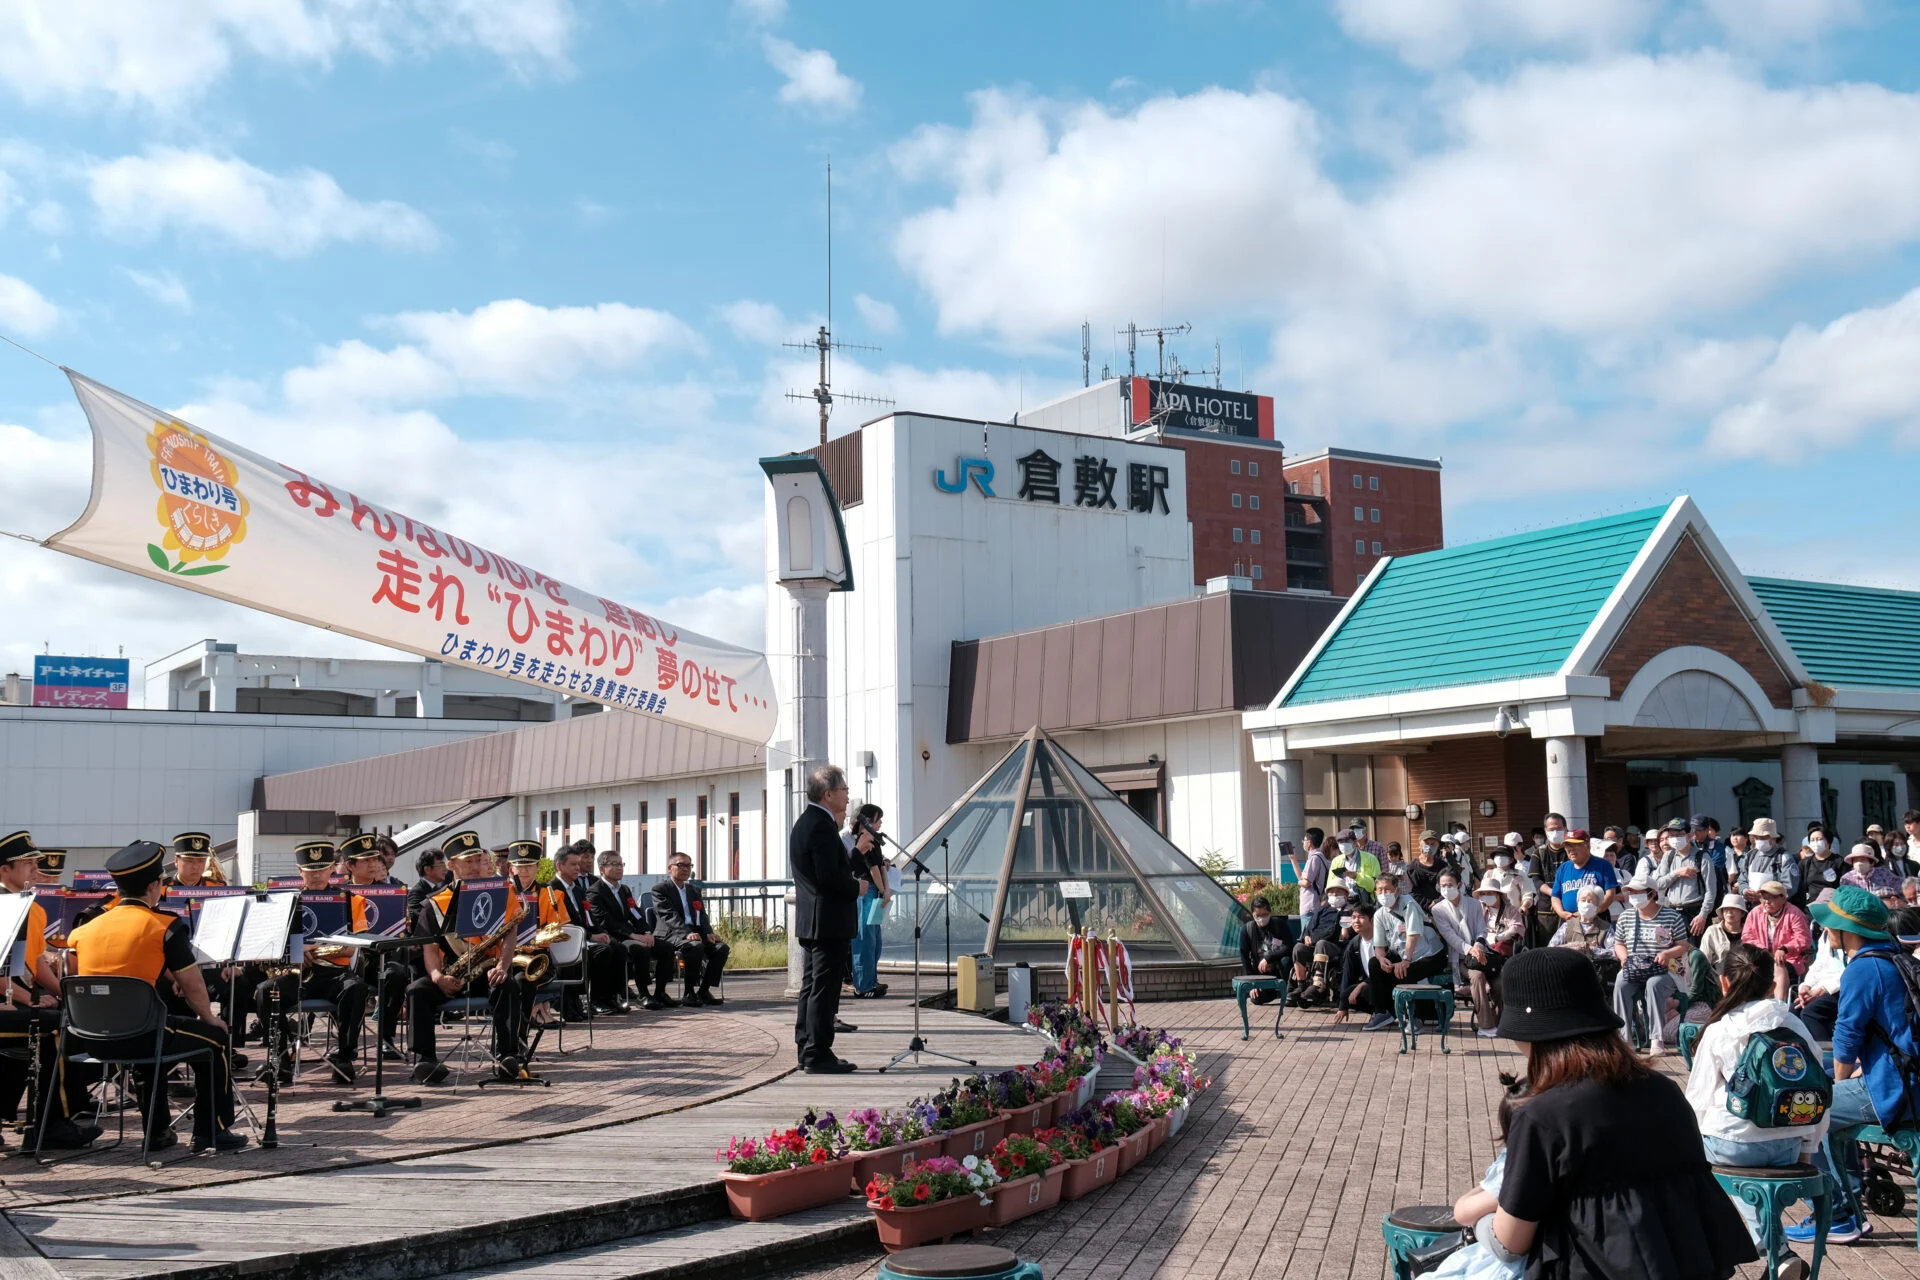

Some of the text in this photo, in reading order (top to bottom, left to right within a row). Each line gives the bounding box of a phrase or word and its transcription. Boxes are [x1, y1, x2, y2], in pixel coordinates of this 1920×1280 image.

[1152, 392, 1252, 420] APA HOTEL
[203, 448, 226, 483] TRAIN
[935, 456, 996, 498] JR
[1016, 449, 1170, 515] 倉敷駅
[160, 467, 238, 512] ひまわり号
[182, 501, 220, 533] くらしき
[39, 665, 125, 678] アートネイチャー
[112, 683, 125, 692] 3F
[440, 633, 668, 716] ひまわり号を走らせる倉敷実行委員会
[53, 690, 108, 701] レディース
